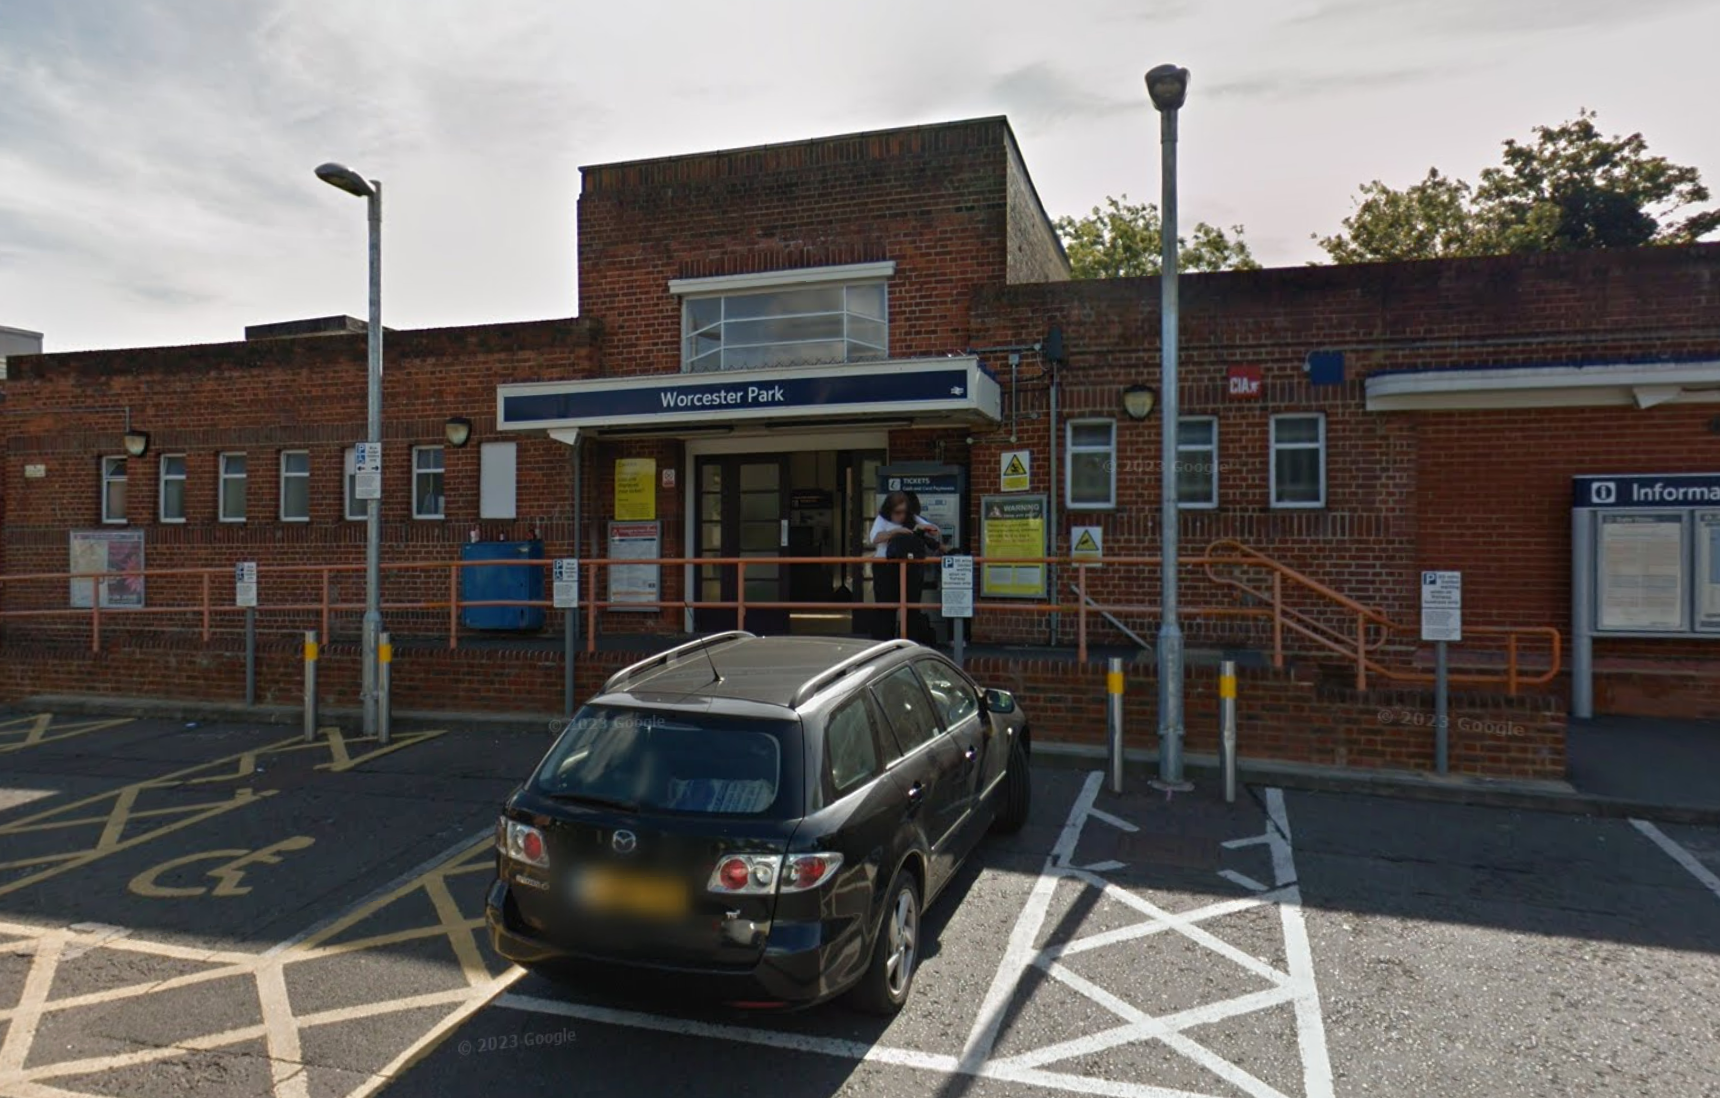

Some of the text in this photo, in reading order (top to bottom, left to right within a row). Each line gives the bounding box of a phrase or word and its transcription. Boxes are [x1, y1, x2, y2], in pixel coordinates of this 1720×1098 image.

[660, 385, 785, 408] Worcester Park
[902, 477, 930, 486] TICKETS
[1003, 503, 1040, 512] WARNING
